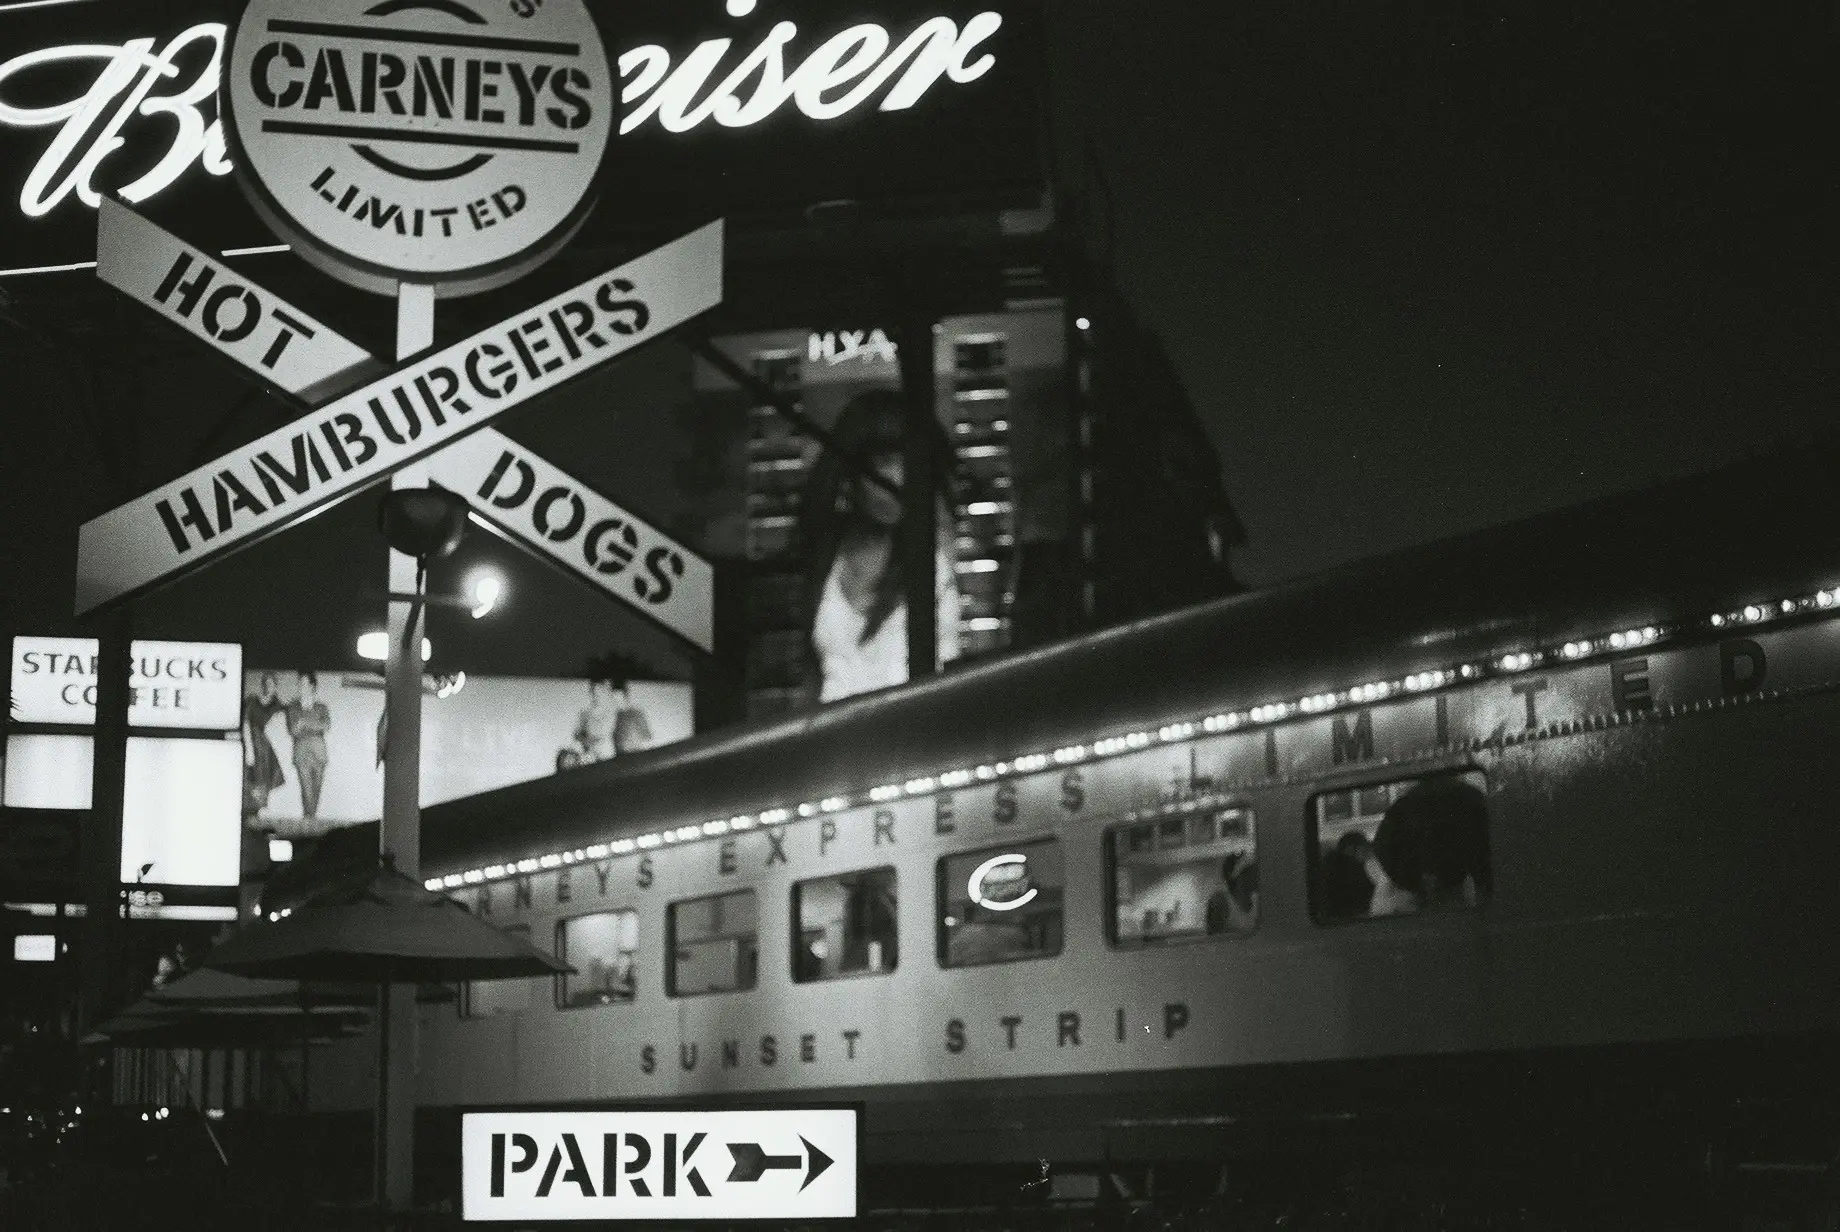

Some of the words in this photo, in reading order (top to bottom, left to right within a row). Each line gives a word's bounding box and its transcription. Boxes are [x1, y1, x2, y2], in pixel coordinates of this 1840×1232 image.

[250, 40, 593, 130] CARNEYS
[310, 167, 527, 237] LIMITED
[153, 250, 316, 370] HOT
[155, 277, 650, 554] HAMBURGERS
[476, 448, 685, 604] DOGS
[22, 652, 227, 680] STAUCKS
[61, 684, 190, 709] COFEE
[719, 768, 1086, 876] EXPRESS
[1190, 638, 1768, 790] LIMITED
[641, 1030, 861, 1073] SUNSET
[946, 1003, 1190, 1055] STRIP
[490, 1132, 712, 1198] PARK
